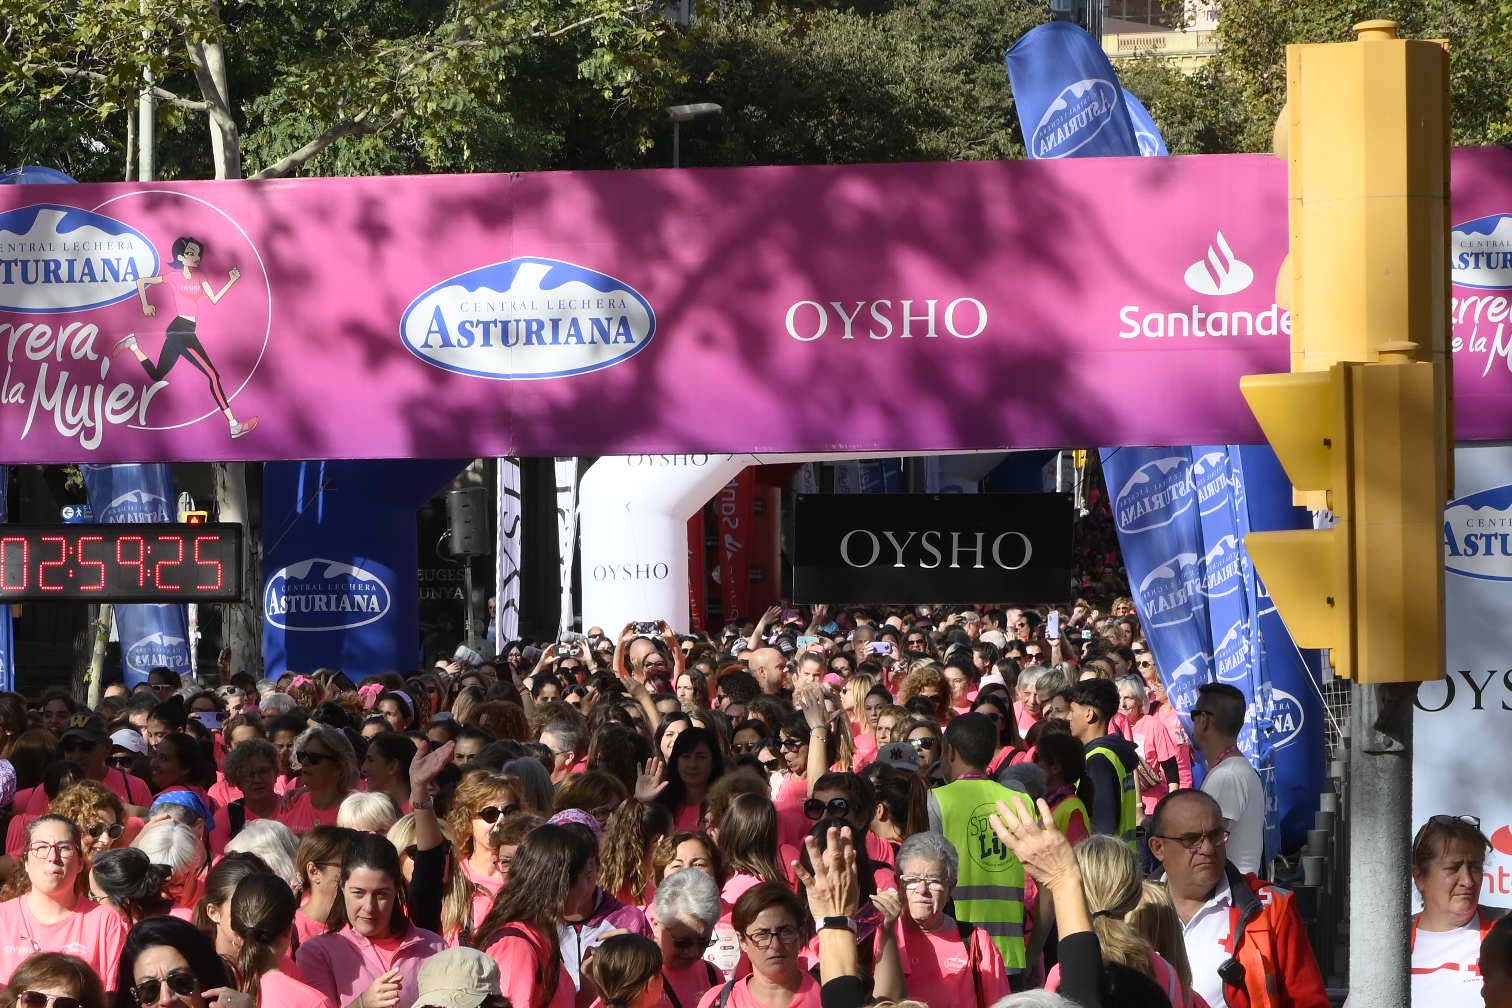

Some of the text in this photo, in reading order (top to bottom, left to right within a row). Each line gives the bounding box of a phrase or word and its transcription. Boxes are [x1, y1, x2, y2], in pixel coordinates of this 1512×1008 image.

[63, 240, 134, 251] LECHERA
[460, 298, 628, 312] CENTRAL LECHERA
[785, 296, 988, 342] OYSHO
[422, 305, 636, 351] ASTURIANA
[1119, 304, 1292, 338] Santande
[1469, 324, 1487, 352] la
[1, 366, 26, 404] la
[20, 356, 170, 450] Mujer
[0, 535, 222, 590] 02:59:25
[840, 529, 1032, 570] OYSHO
[281, 583, 377, 592] CENTRAL LECHERA
[593, 562, 669, 583] OYSHO
[269, 588, 381, 616] ASTURIANA
